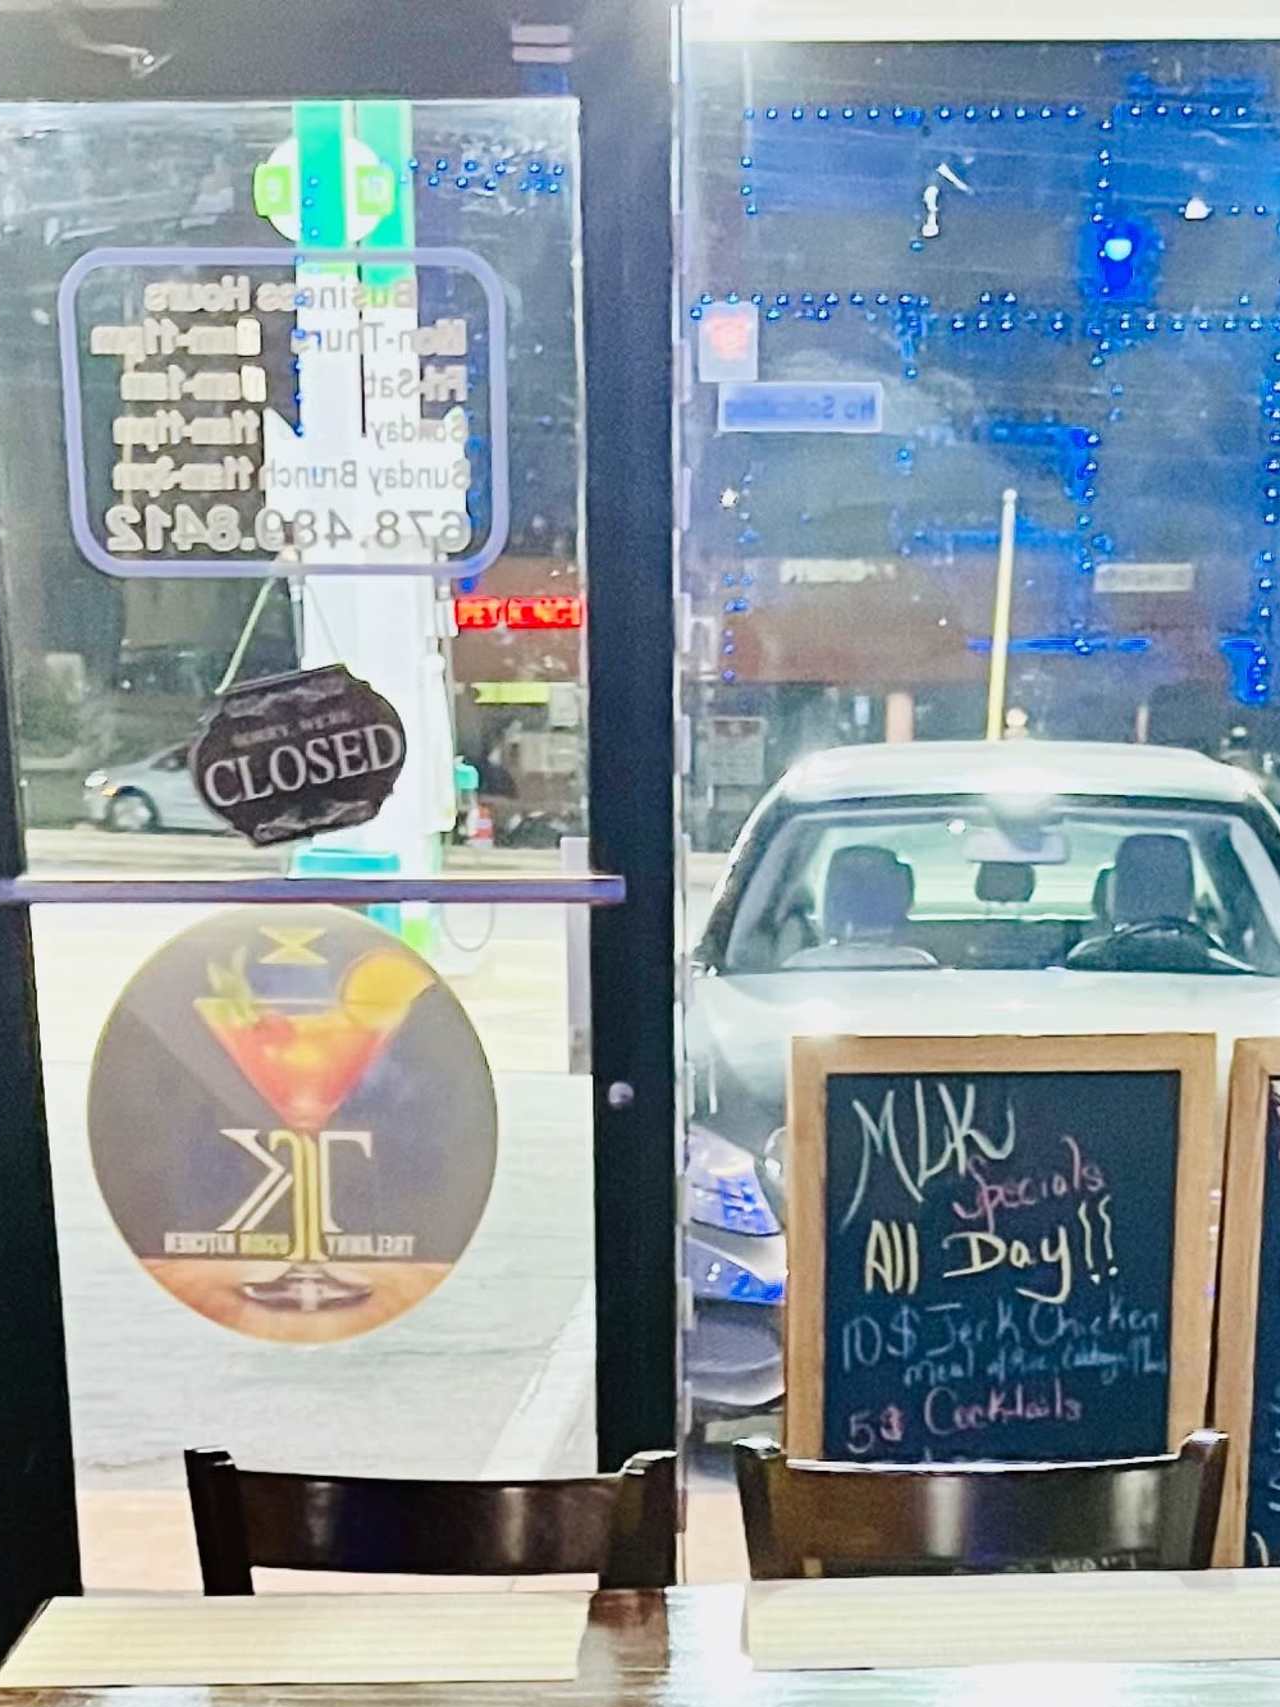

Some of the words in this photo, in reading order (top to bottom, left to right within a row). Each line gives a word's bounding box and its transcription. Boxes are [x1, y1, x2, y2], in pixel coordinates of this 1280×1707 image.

[204, 723, 402, 808] CLOSED
[839, 1079, 1017, 1233] MLK
[865, 1219, 919, 1295] All
